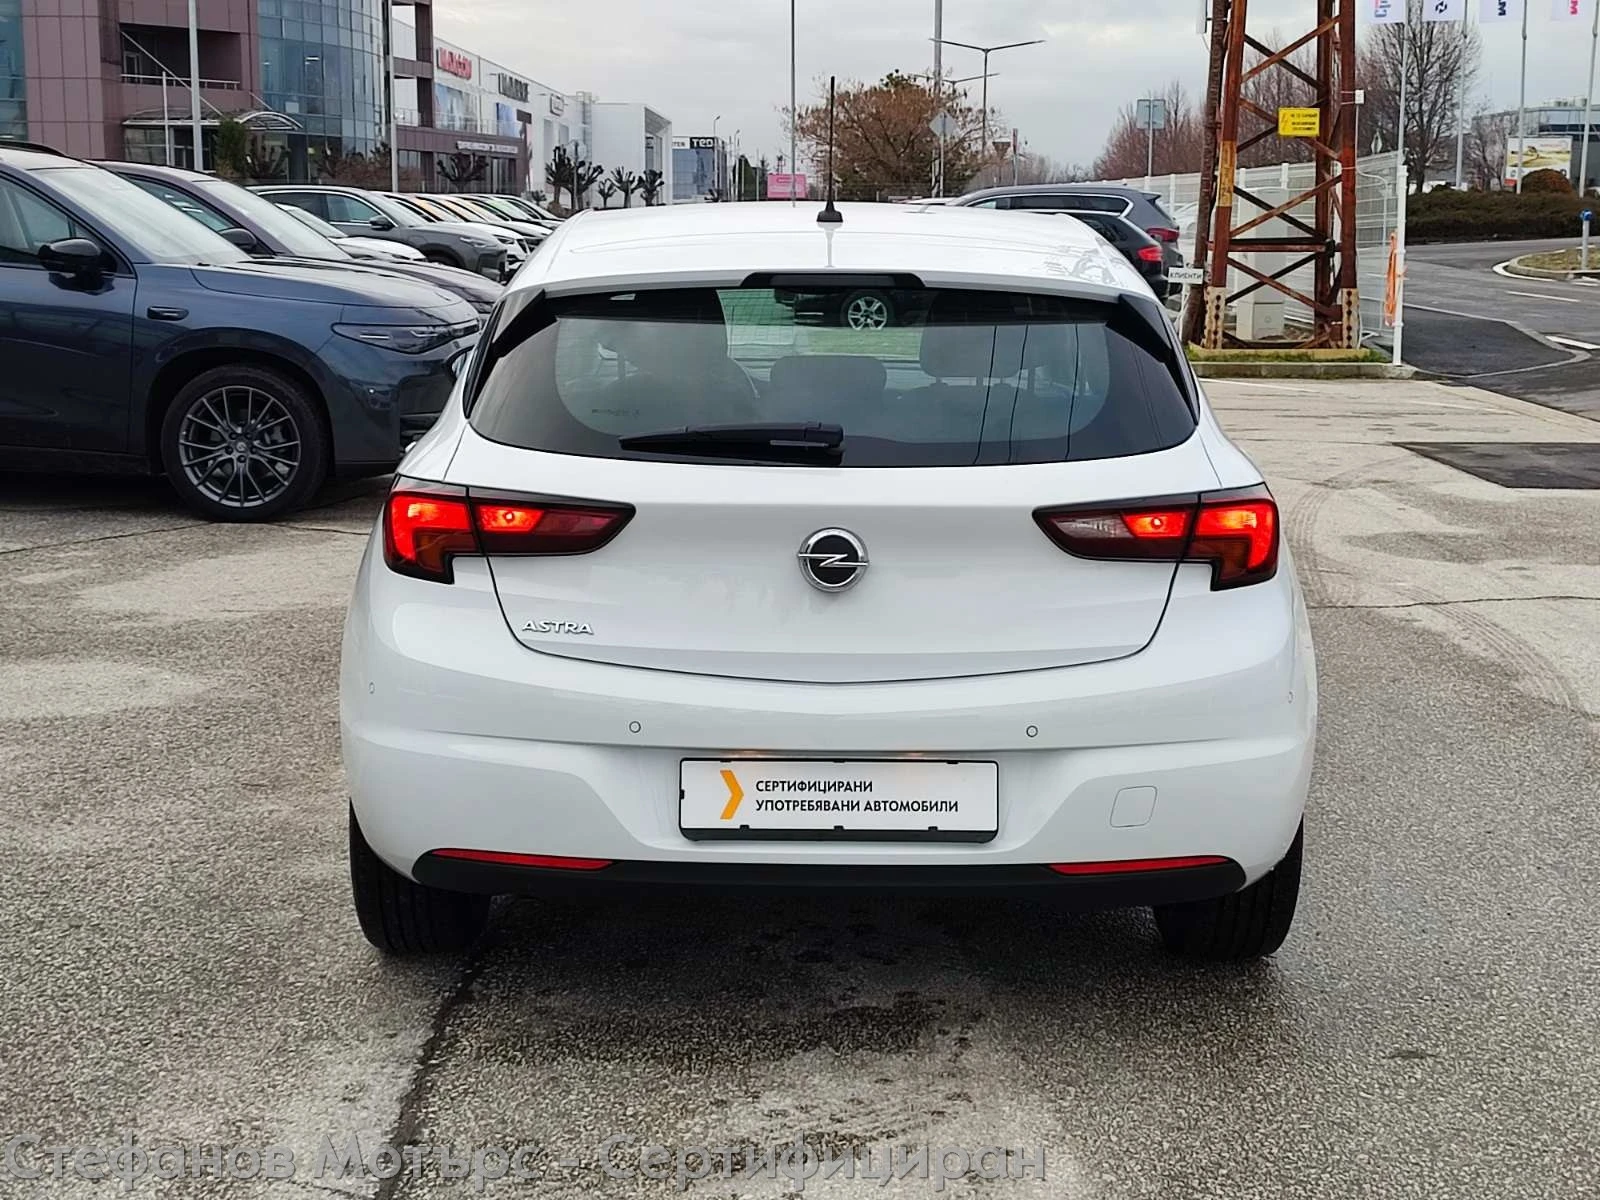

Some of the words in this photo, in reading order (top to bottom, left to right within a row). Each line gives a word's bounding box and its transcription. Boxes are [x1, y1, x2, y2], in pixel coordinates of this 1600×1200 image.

[1170, 272, 1202, 280] КЛИЕНТИ
[522, 620, 594, 635] ASTRA
[755, 779, 873, 793] СЕРТИФИЦИРАНИ
[755, 798, 860, 813] УПОТРЕБЯВАНИ
[863, 799, 959, 813] АВТОМОБИЛИ
